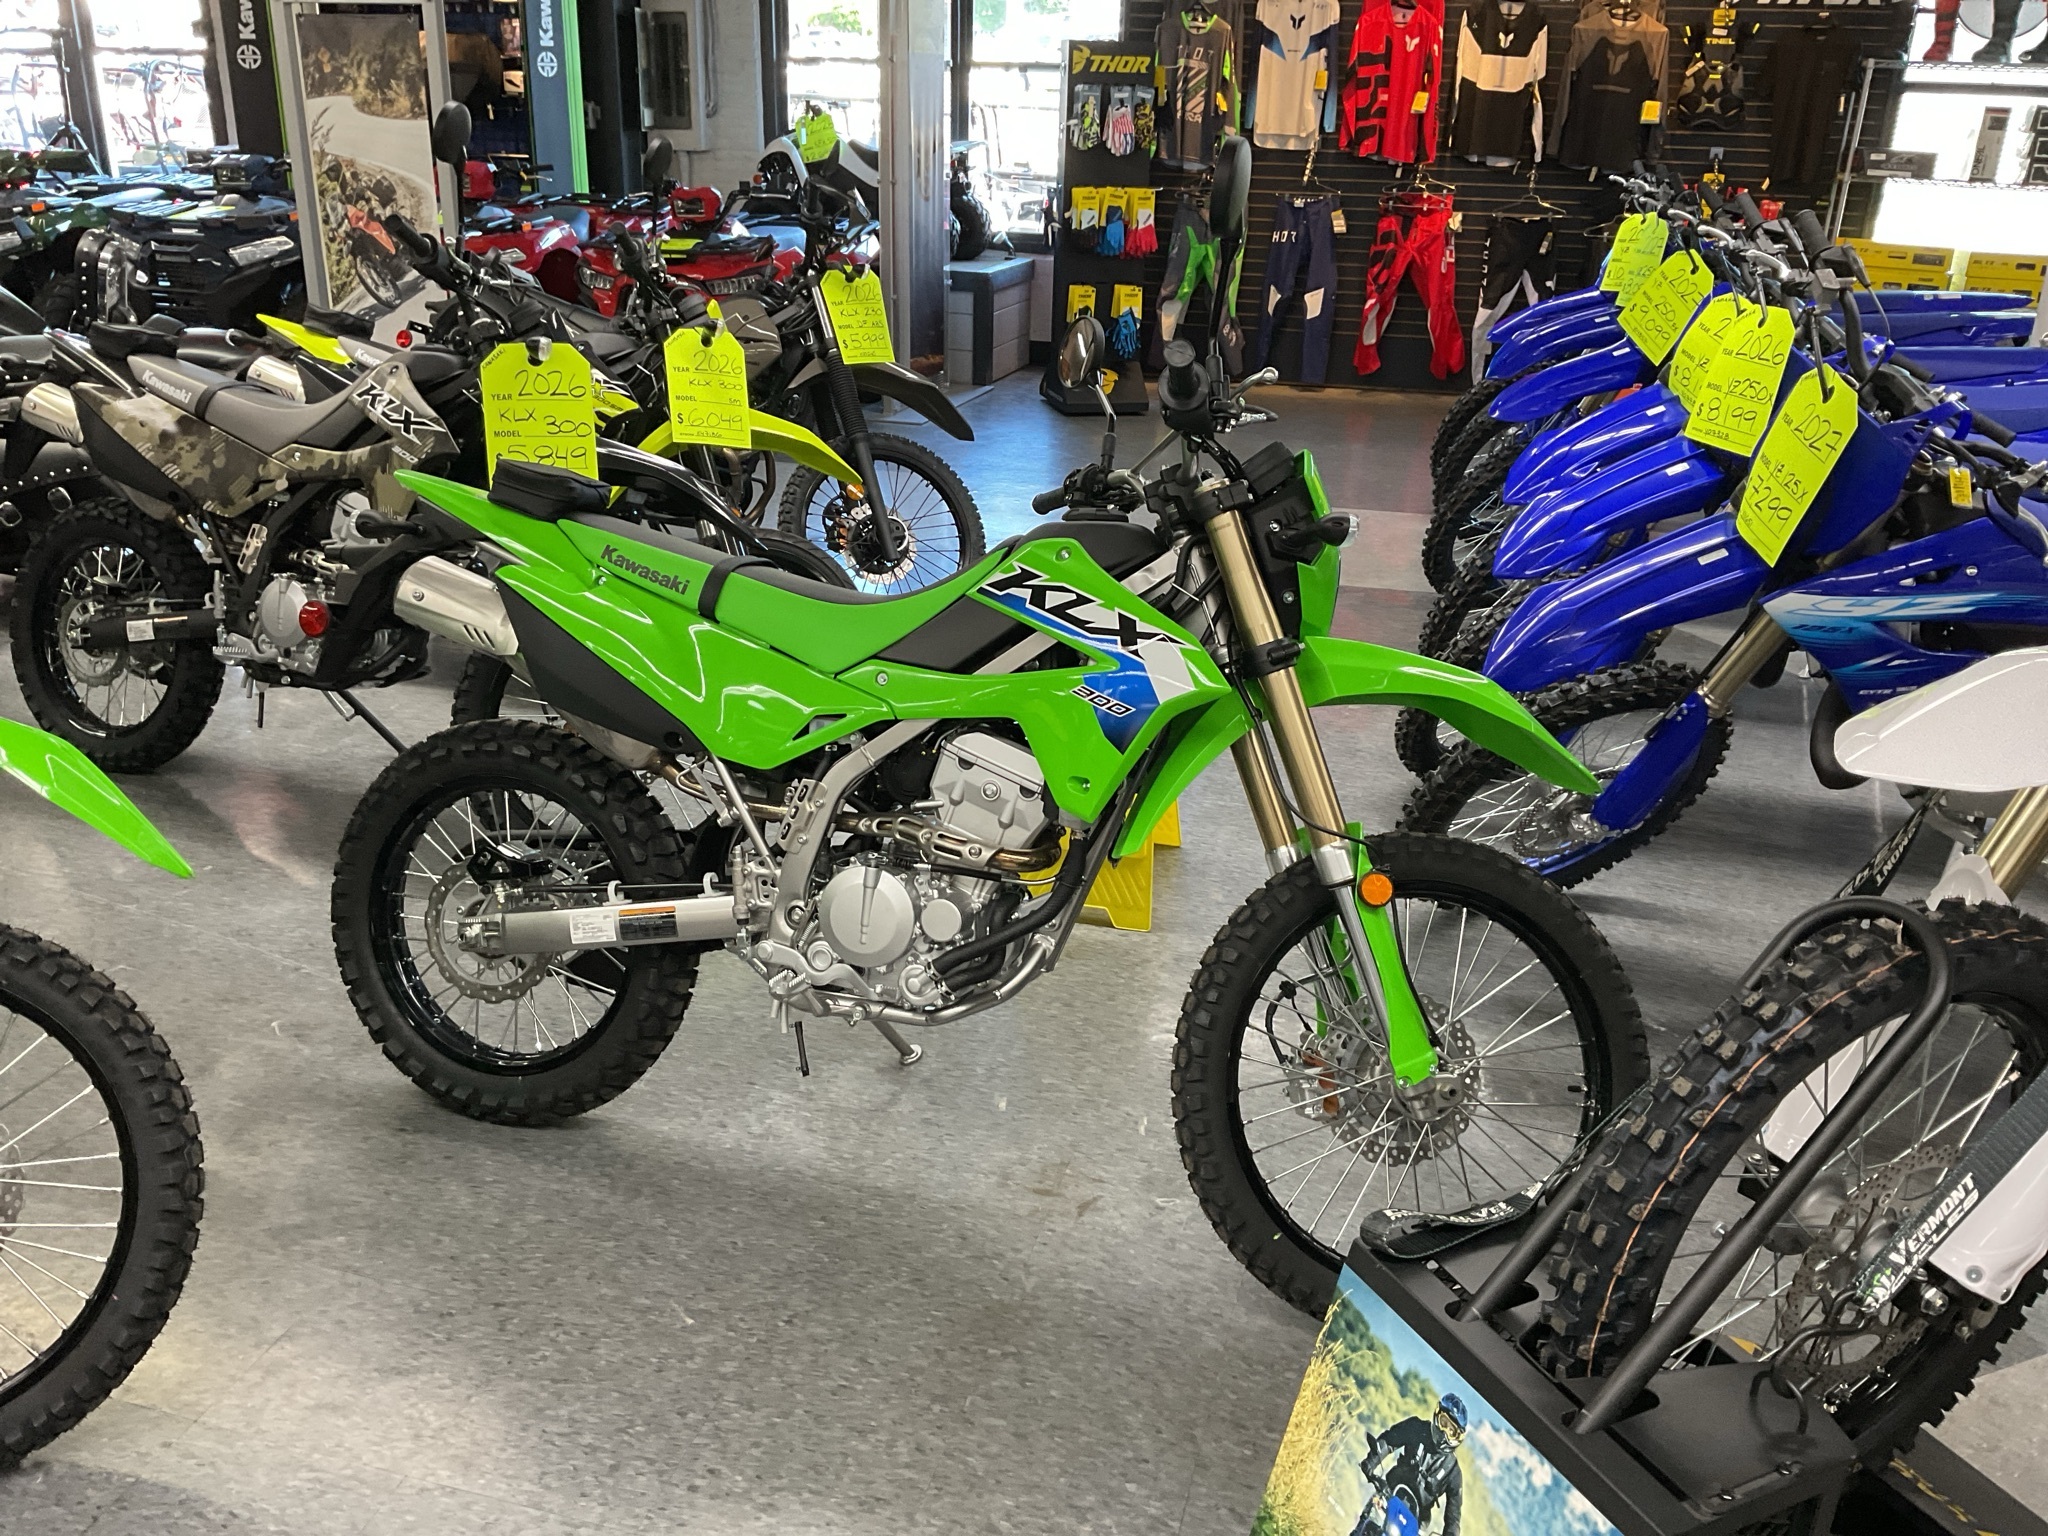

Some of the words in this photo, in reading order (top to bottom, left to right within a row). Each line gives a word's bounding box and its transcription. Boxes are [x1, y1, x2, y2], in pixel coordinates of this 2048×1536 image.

[1090, 54, 1151, 73] THOR
[1699, 321, 1711, 334] YEAR
[693, 350, 743, 375] 2026
[1681, 348, 1696, 364] MODEL
[1722, 347, 1734, 357] YEAR
[1736, 330, 1785, 366] 2026
[142, 369, 192, 403] Kawasaki
[515, 370, 587, 398] 2026
[689, 379, 712, 387] KLX
[718, 379, 743, 391] 300
[1706, 382, 1723, 393] MODEL
[352, 378, 447, 445] KLX
[498, 408, 537, 423] KLX
[544, 416, 592, 438] 300
[1781, 411, 1793, 429] YEAR
[1794, 403, 1842, 463] 2027
[391, 445, 419, 464] 300
[601, 544, 690, 595] Kawasaki
[979, 561, 1199, 661] KLX
[1069, 684, 1136, 718] 300
[1888, 1171, 1976, 1266] VERMONT
